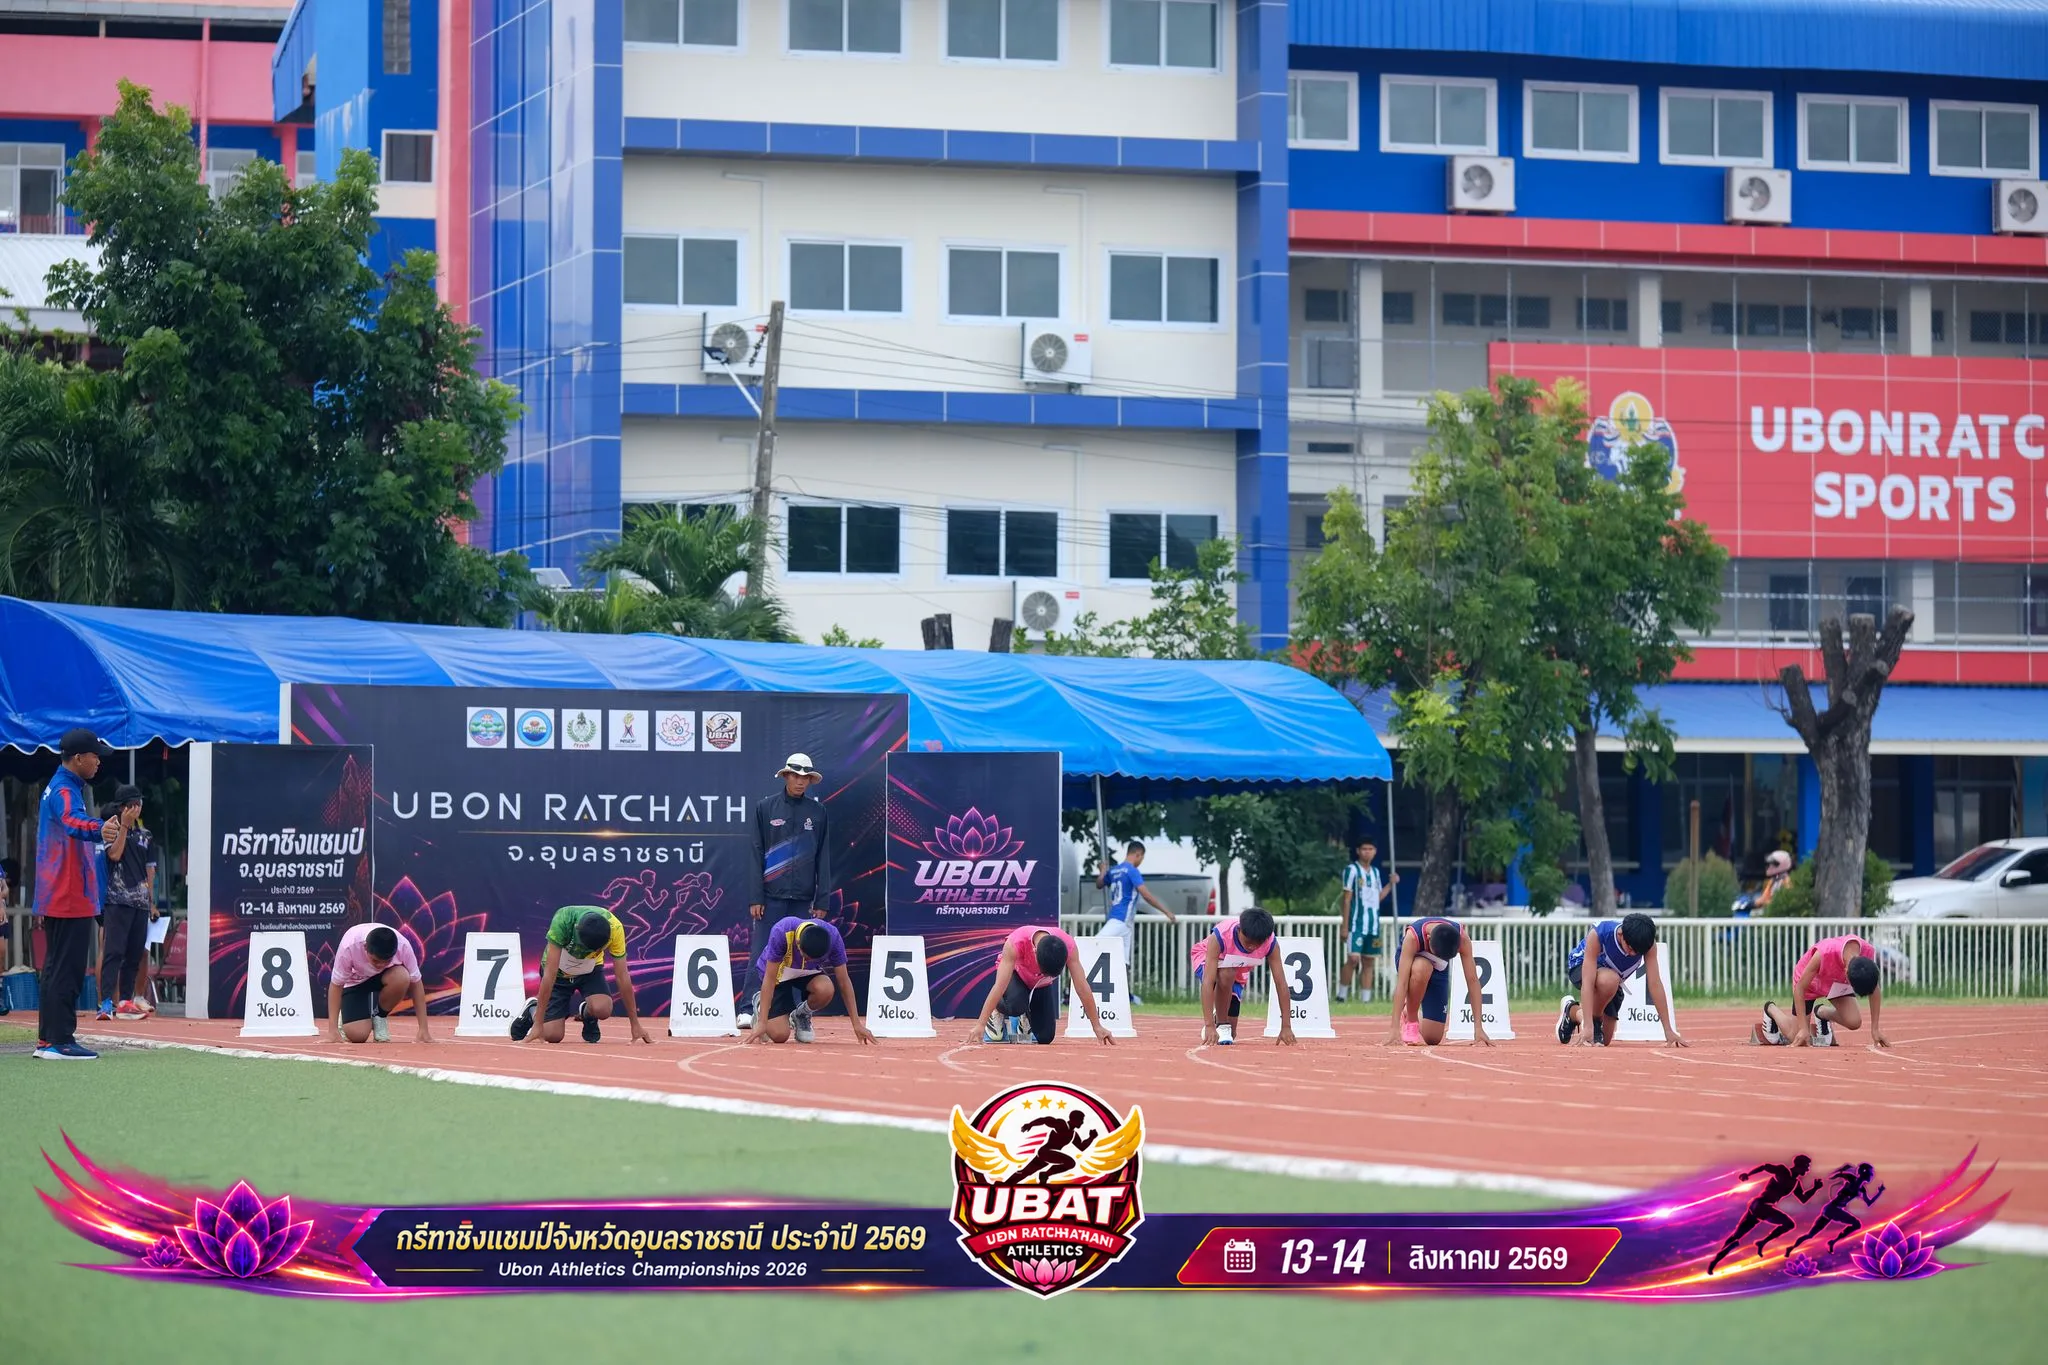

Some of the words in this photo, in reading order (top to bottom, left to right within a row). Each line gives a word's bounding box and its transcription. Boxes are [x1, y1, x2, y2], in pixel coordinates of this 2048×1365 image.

[1750, 405, 2045, 460] UBONRATC
[1813, 471, 2016, 522] SPORTS
[393, 791, 521, 820] UBON
[507, 840, 705, 870] จ.อุบลราชธานี
[239, 857, 345, 884] จ.อุบลราชธานี
[914, 860, 1039, 887] UBON
[296, 886, 315, 895] 2569
[915, 887, 1031, 903] ATHLETICS
[240, 902, 274, 915] 12-14
[277, 901, 316, 915] สิงหาคม
[319, 902, 346, 915] 2569
[261, 947, 294, 999] 8
[476, 948, 510, 1001] 7
[687, 947, 719, 999] 6
[882, 950, 914, 1002] 5
[1086, 952, 1115, 1003] 4
[1284, 951, 1314, 1002] 3
[1464, 956, 1493, 1005] 2
[256, 1002, 296, 1017] Nelco
[472, 1003, 511, 1018] Nelco
[682, 1001, 720, 1017] Nelco
[878, 1004, 915, 1020] Nelco
[1460, 1008, 1495, 1023] Neco
[1627, 1007, 1660, 1022] Nelco
